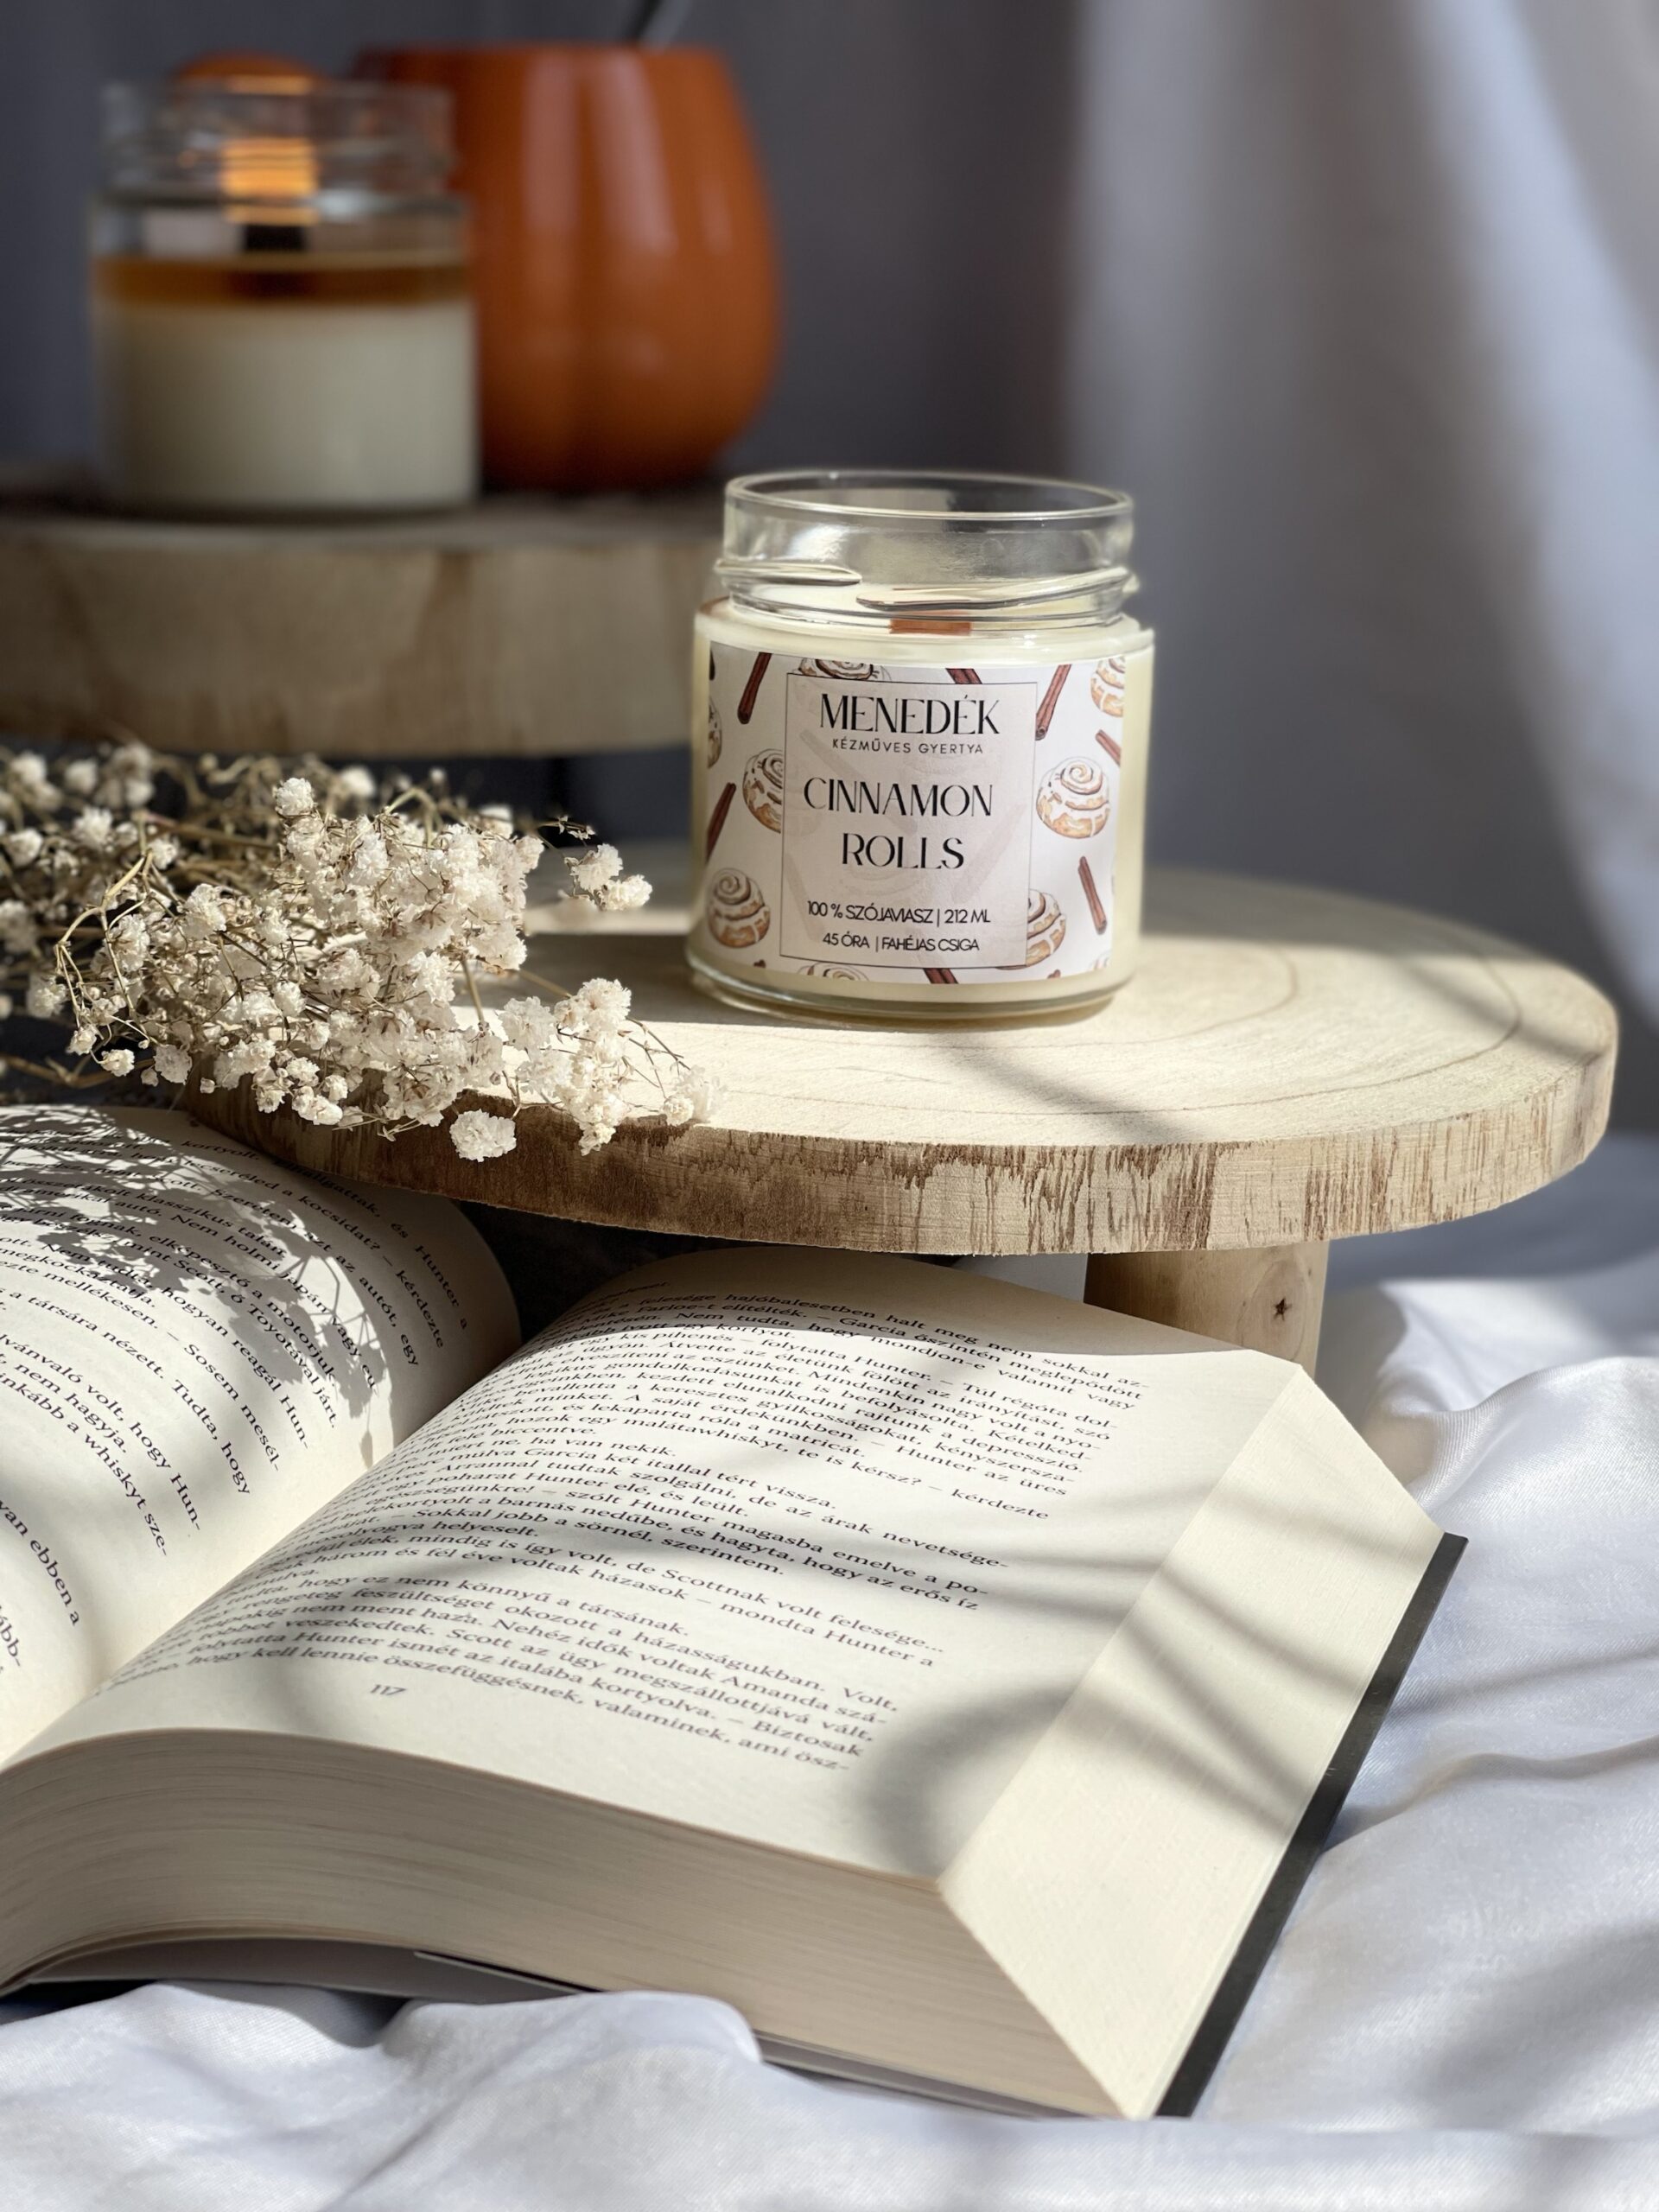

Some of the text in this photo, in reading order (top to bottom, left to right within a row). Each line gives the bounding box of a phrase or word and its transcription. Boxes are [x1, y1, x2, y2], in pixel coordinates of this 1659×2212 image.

[820, 693, 1001, 735] MENEDÉK
[832, 737, 983, 754] KÉZMŰVES GYERTYA
[804, 778, 993, 817] CINNAMON
[842, 832, 964, 870] ROLLS
[808, 900, 828, 918] 100
[845, 902, 934, 925] SZÓJAVIASZ
[944, 910, 969, 925] 212
[970, 910, 991, 924] ML
[823, 931, 980, 951] 45 ÓRA FAHÉJAS CSIGA
[136, 1192, 234, 1229] klasszikus
[114, 1198, 362, 1358] autó. Nem holmi japán vagy
[213, 1188, 298, 1230] Szeretem
[305, 1231, 333, 1252] azt
[336, 1255, 355, 1273] az
[359, 1276, 396, 1327] autót,
[400, 1333, 419, 1367] egy
[298, 1195, 380, 1251] kocsidat?
[396, 1269, 443, 1349] kérdezte
[390, 1220, 409, 1239] és
[414, 1244, 461, 1308] Hunter
[41, 1243, 309, 1449] Nem tudta, hogyan reagál Hun-
[124, 1241, 338, 1428] mint Scott, Toyotával járt.
[149, 1234, 250, 1288] elképesztő
[267, 1300, 336, 1388] motorjuk.
[726, 1293, 1110, 1380] hajóbalesetben halt sokkal
[28, 1294, 251, 1495] társára nézett. Tudta, hogy
[43, 1271, 279, 1471] mellékesen. Sosem mesél-
[701, 1355, 926, 1406] eszünket. Mindenkin
[760, 1338, 847, 1361] folytatta
[853, 1355, 931, 1382] Hunter.
[1001, 1395, 1068, 1419] régóta
[773, 1353, 854, 1374] életünk
[861, 1370, 921, 1391] fölött
[839, 1316, 1141, 1400] Garcia őszintén meglepődött
[869, 1334, 1075, 1395] mondjon-e valamit
[14, 1363, 128, 1453] nem hagyja.
[590, 1402, 866, 1459] lekaparta matricát.
[602, 1360, 1090, 1460] gondolkodásunkat befolyásolta. Kételked-
[609, 1442, 677, 1458] nekik.
[635, 1370, 1084, 1474] kezdett eluralkodni rajtunk depresszió.
[649, 1382, 750, 1403] keresztes
[755, 1400, 923, 1446] gyilkosságokat,
[934, 1440, 1074, 1483] kényszersza-
[651, 1396, 977, 1472] saját érdekünkben. Hunter
[84, 1433, 147, 1510] whiskyt
[144, 1512, 167, 1556] sze-
[86, 1383, 200, 1530] volt, hogy Hun-
[426, 1471, 749, 1517] poharat Hunter leült.
[523, 1447, 836, 1510] Garcia itallal vissza.
[622, 1418, 1049, 1520] malátawhiskyt, kérsz? kérdezte
[429, 1518, 538, 1537] helyeselt.
[490, 1510, 550, 1523] jobb
[573, 1521, 654, 1543] sörnél,
[659, 1538, 785, 1576] szerintem.
[496, 1496, 577, 1512] barnás
[709, 1530, 797, 1563] hagyta,
[801, 1555, 866, 1581] hogy
[546, 1460, 622, 1477] tudtak
[628, 1471, 737, 1500] szolgálni,
[881, 1531, 1009, 1568] nevetsége-
[564, 1490, 918, 1578] szólt magasba emelve
[29, 1539, 73, 1607] ebben
[407, 1533, 494, 1548] mindig
[568, 1549, 618, 1567] volt,
[660, 1569, 769, 1605] Scottnak
[455, 1579, 689, 1637] könnyű társának.
[510, 1556, 584, 1576] voltak
[588, 1567, 689, 1600] házasok
[719, 1603, 816, 1636] mondta
[823, 1630, 915, 1661] Hunter
[290, 1631, 385, 1647] Hunter
[386, 1637, 461, 1657] ismét
[499, 1656, 584, 1685] italába
[350, 1586, 825, 1692] feszültséget okozott házasságukban.
[445, 1628, 513, 1649] Scott
[613, 1666, 810, 1725] megszállottjává
[490, 1618, 830, 1712] Nehéz idők voltak Amanda
